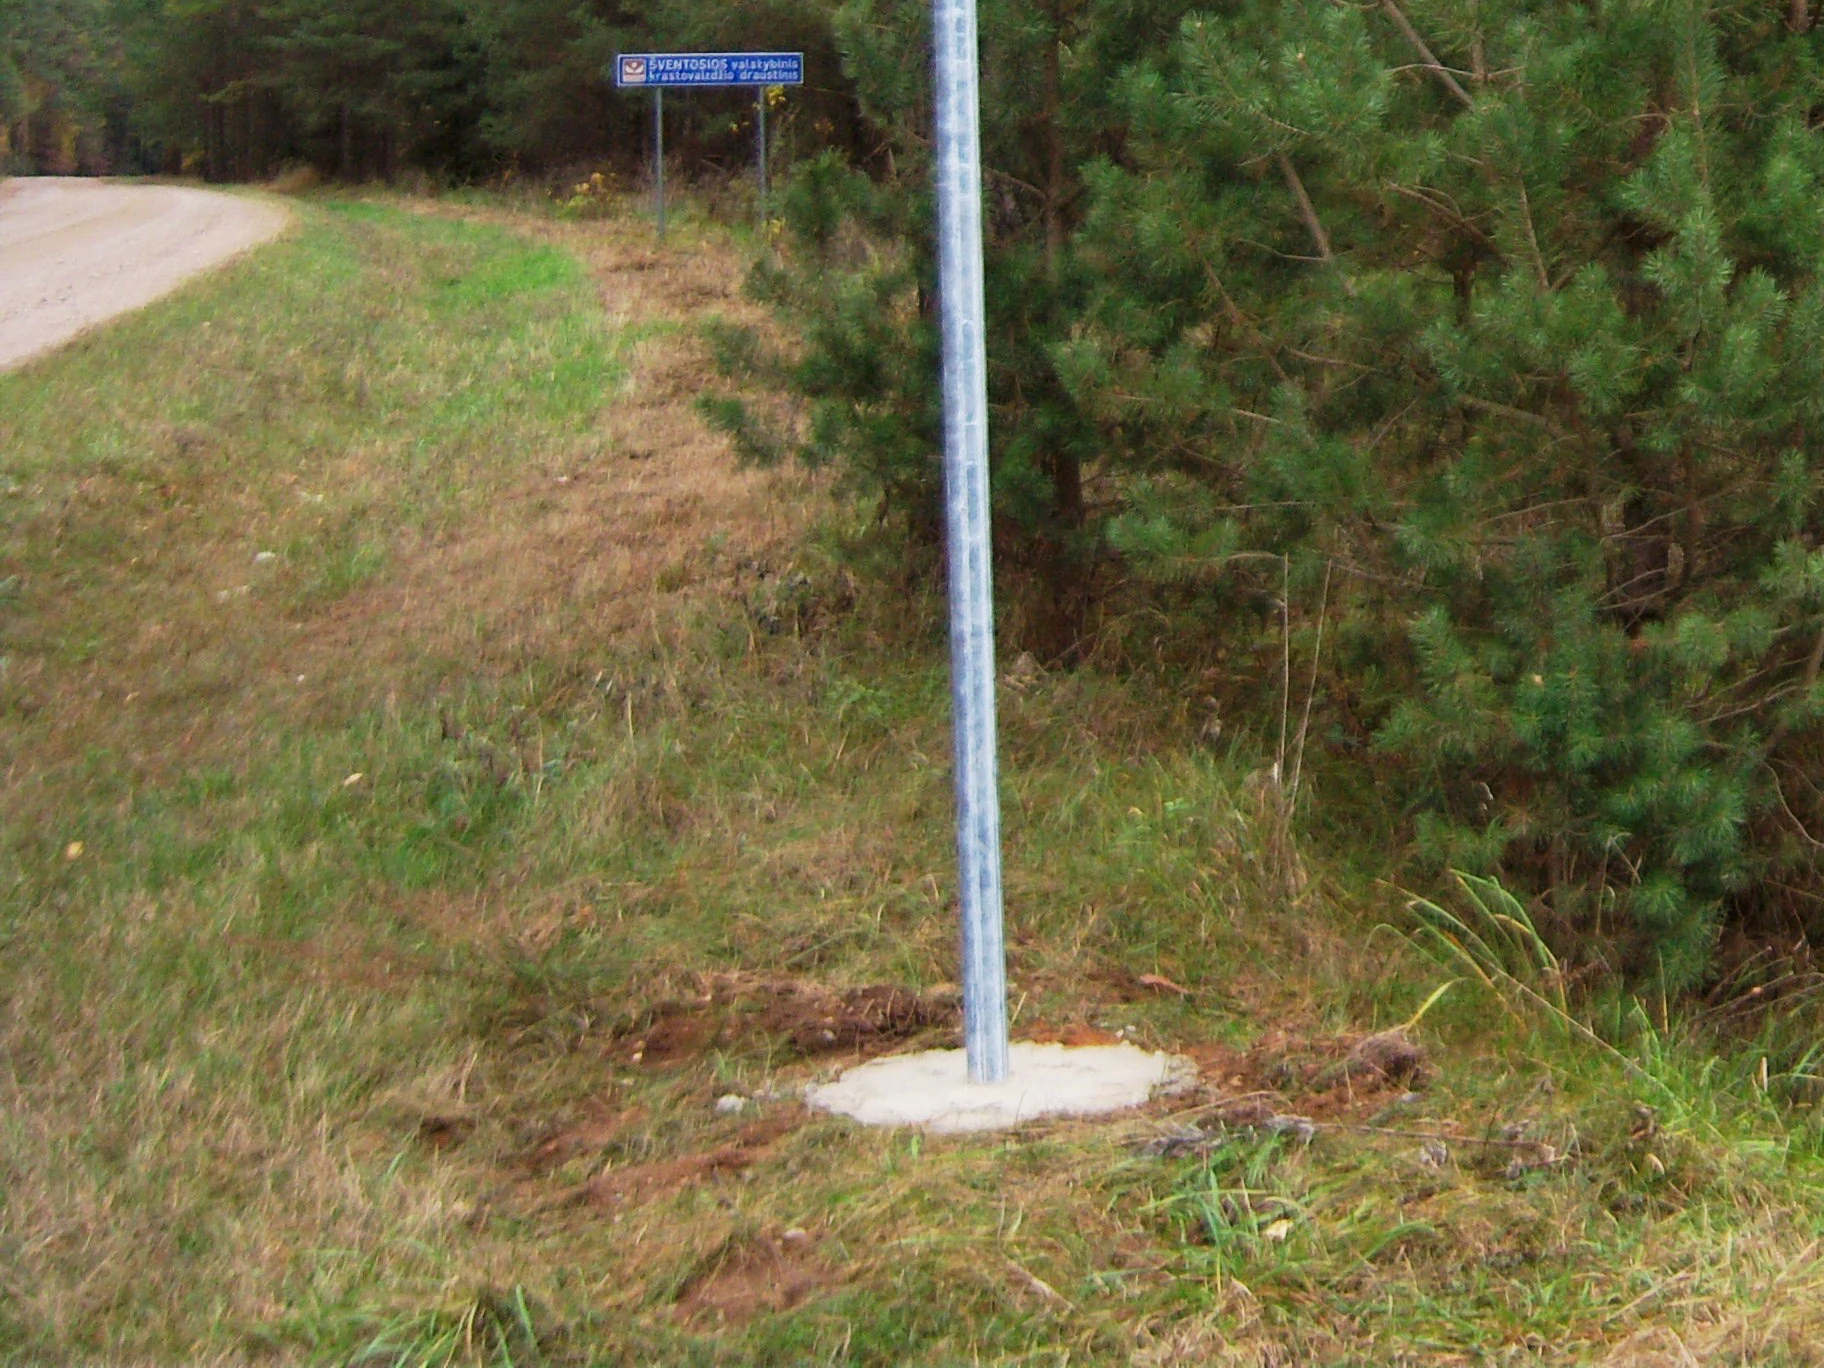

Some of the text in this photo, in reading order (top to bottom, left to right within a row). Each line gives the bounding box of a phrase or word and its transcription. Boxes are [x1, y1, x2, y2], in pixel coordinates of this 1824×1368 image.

[649, 56, 799, 73] ŠVENTOSIOS valstybinis
[739, 70, 799, 82] draustinis
